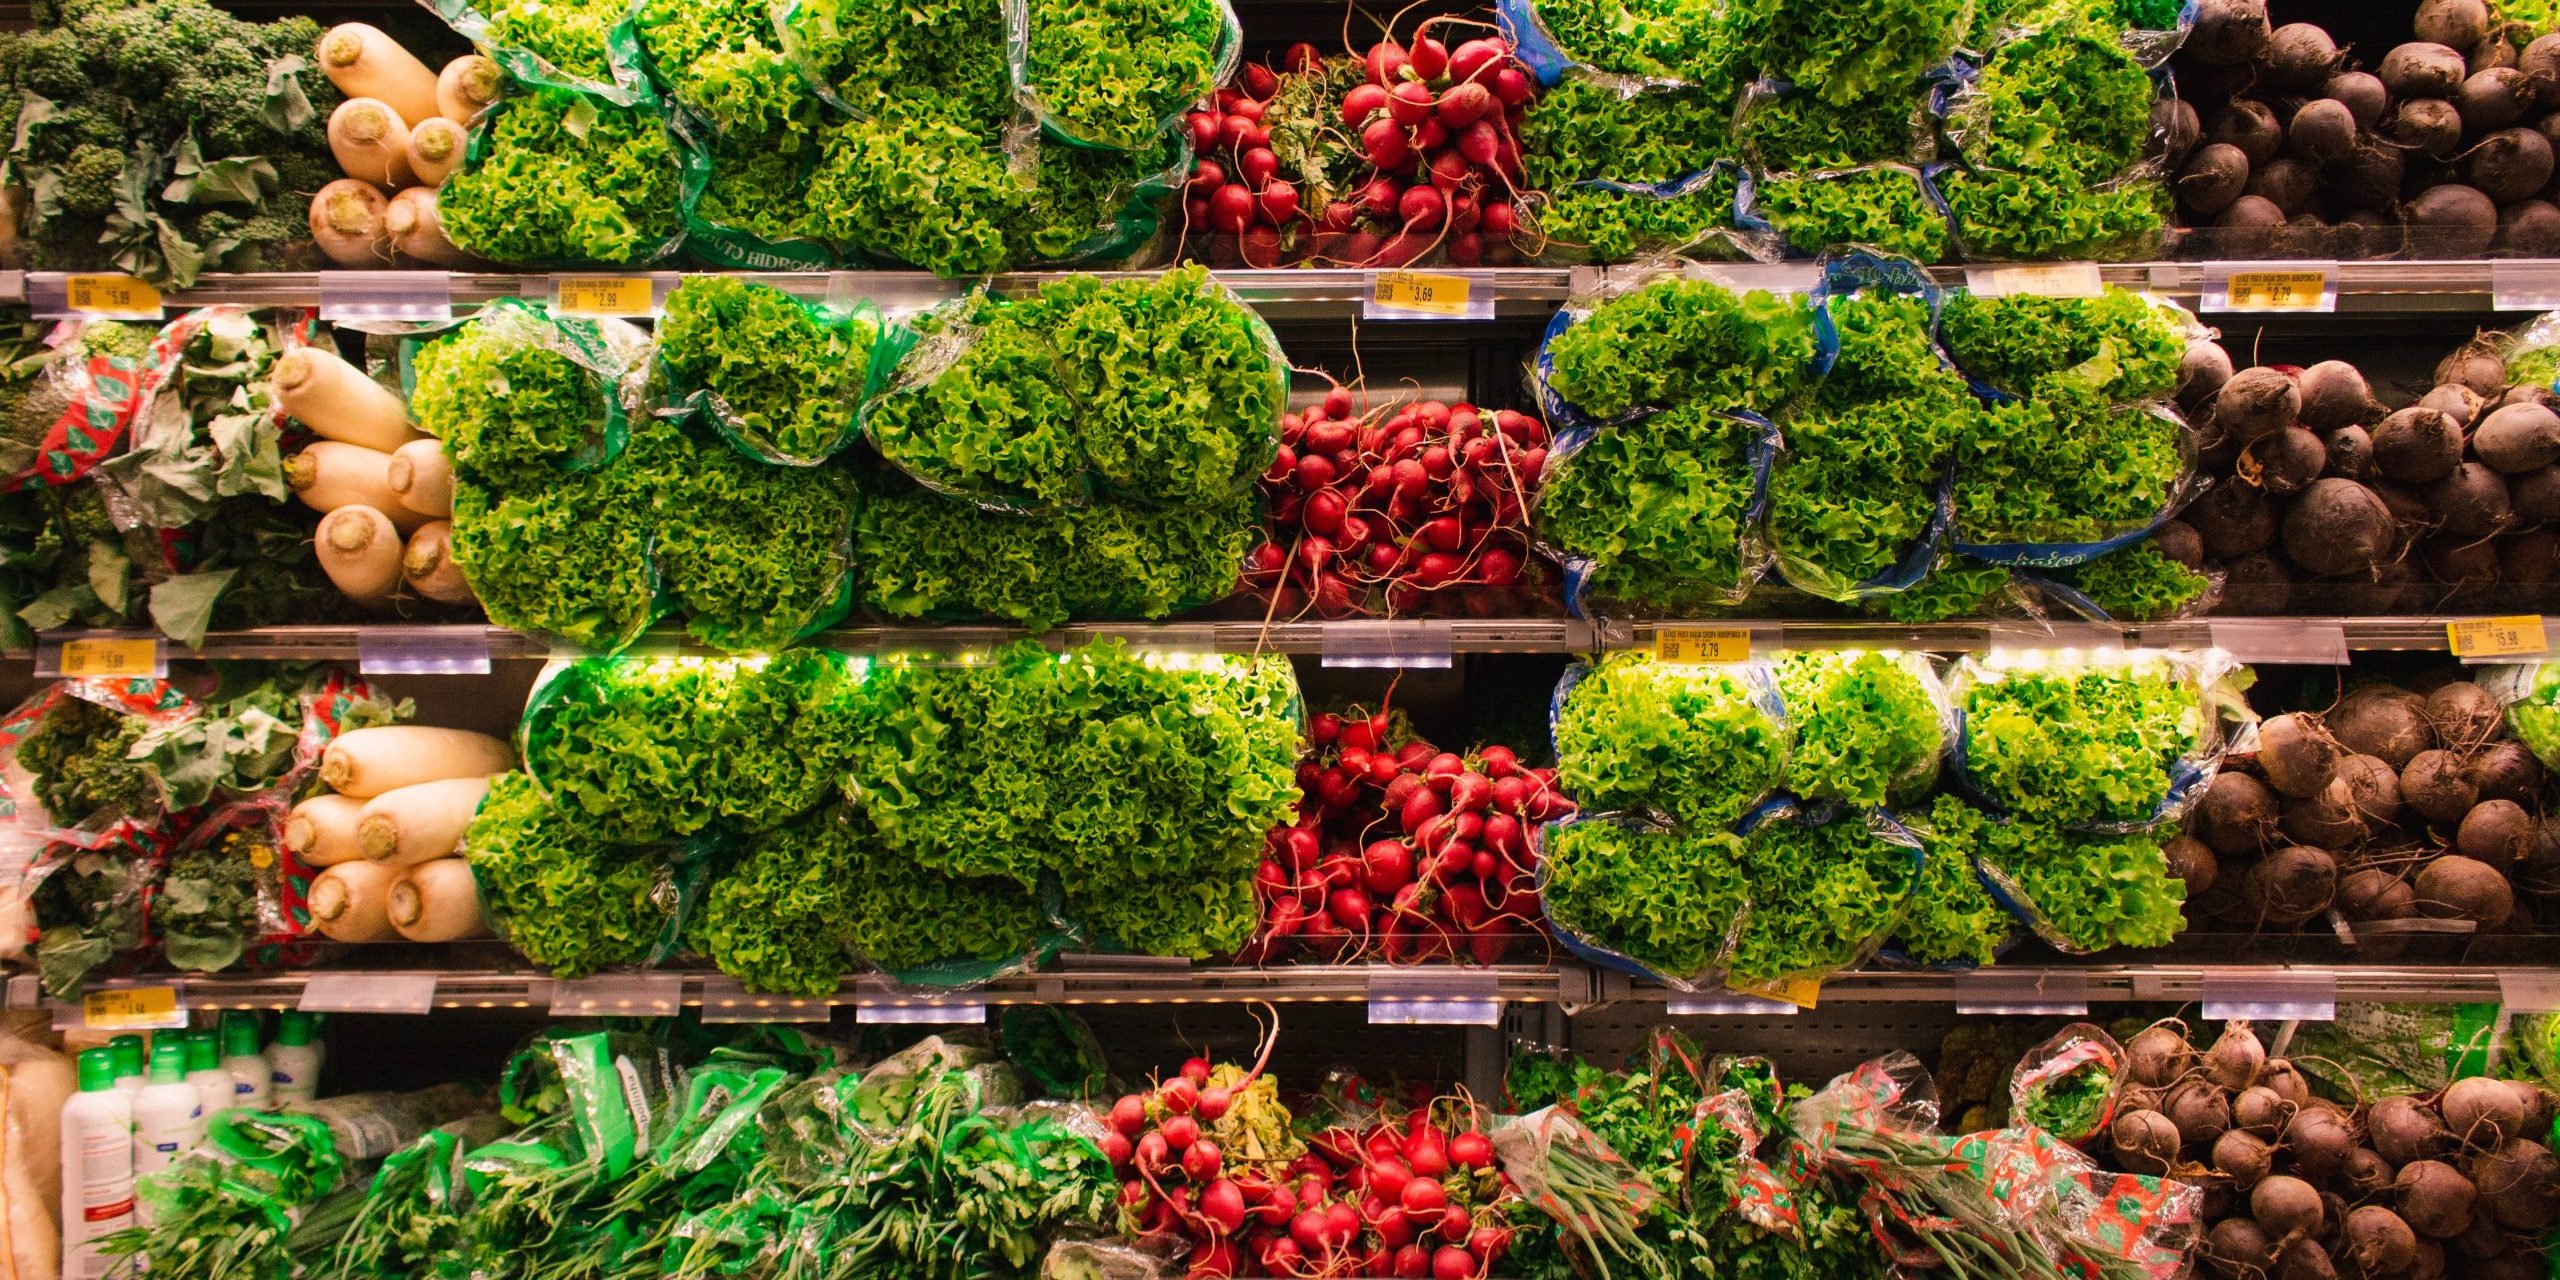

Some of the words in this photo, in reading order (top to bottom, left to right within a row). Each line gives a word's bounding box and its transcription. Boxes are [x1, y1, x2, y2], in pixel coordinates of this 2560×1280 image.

[1414, 286, 1433, 302] 3,69
[2272, 286, 2292, 302] 2,79
[1701, 642, 1719, 658] 2,79
[627, 1074, 648, 1137] bolinha
